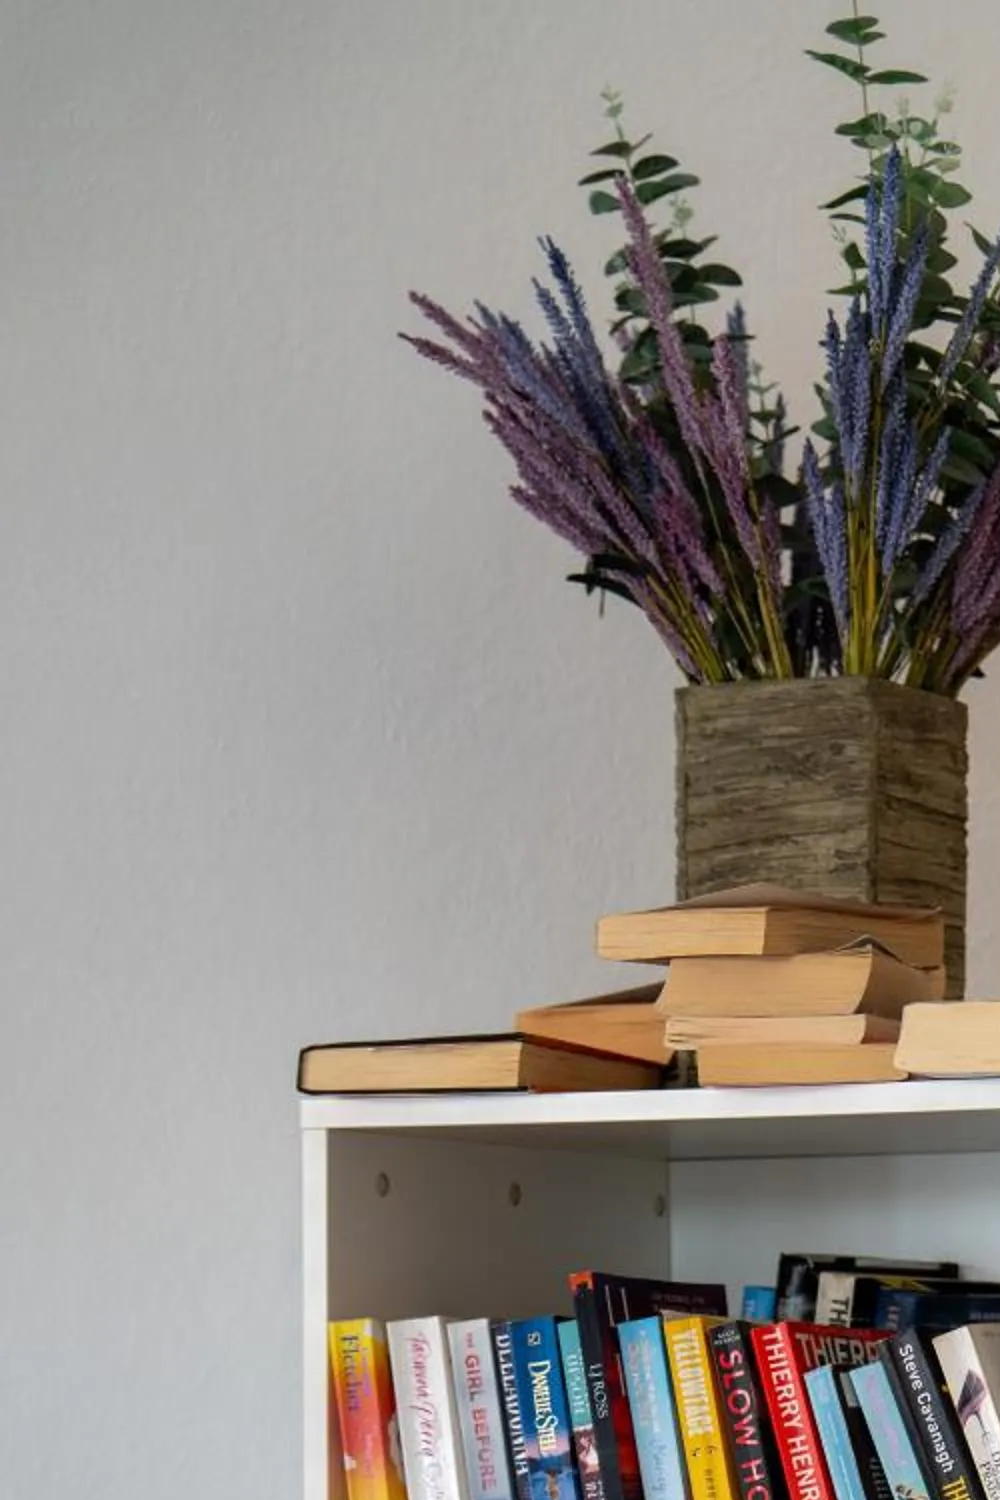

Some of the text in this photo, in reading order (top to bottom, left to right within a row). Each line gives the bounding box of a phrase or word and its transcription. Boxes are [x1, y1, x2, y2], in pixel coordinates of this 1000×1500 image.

[340, 1334, 363, 1413] Fletcher
[464, 1354, 484, 1401] GIRL
[527, 1359, 554, 1415] DANIELLE
[592, 1382, 609, 1419] ROSS
[671, 1327, 713, 1438] YELLOWFACE
[719, 1349, 758, 1447] SLOW
[761, 1327, 802, 1430] THIERRY
[897, 1343, 955, 1474] Steve Cavanagh
[472, 1408, 498, 1491] BEFORE
